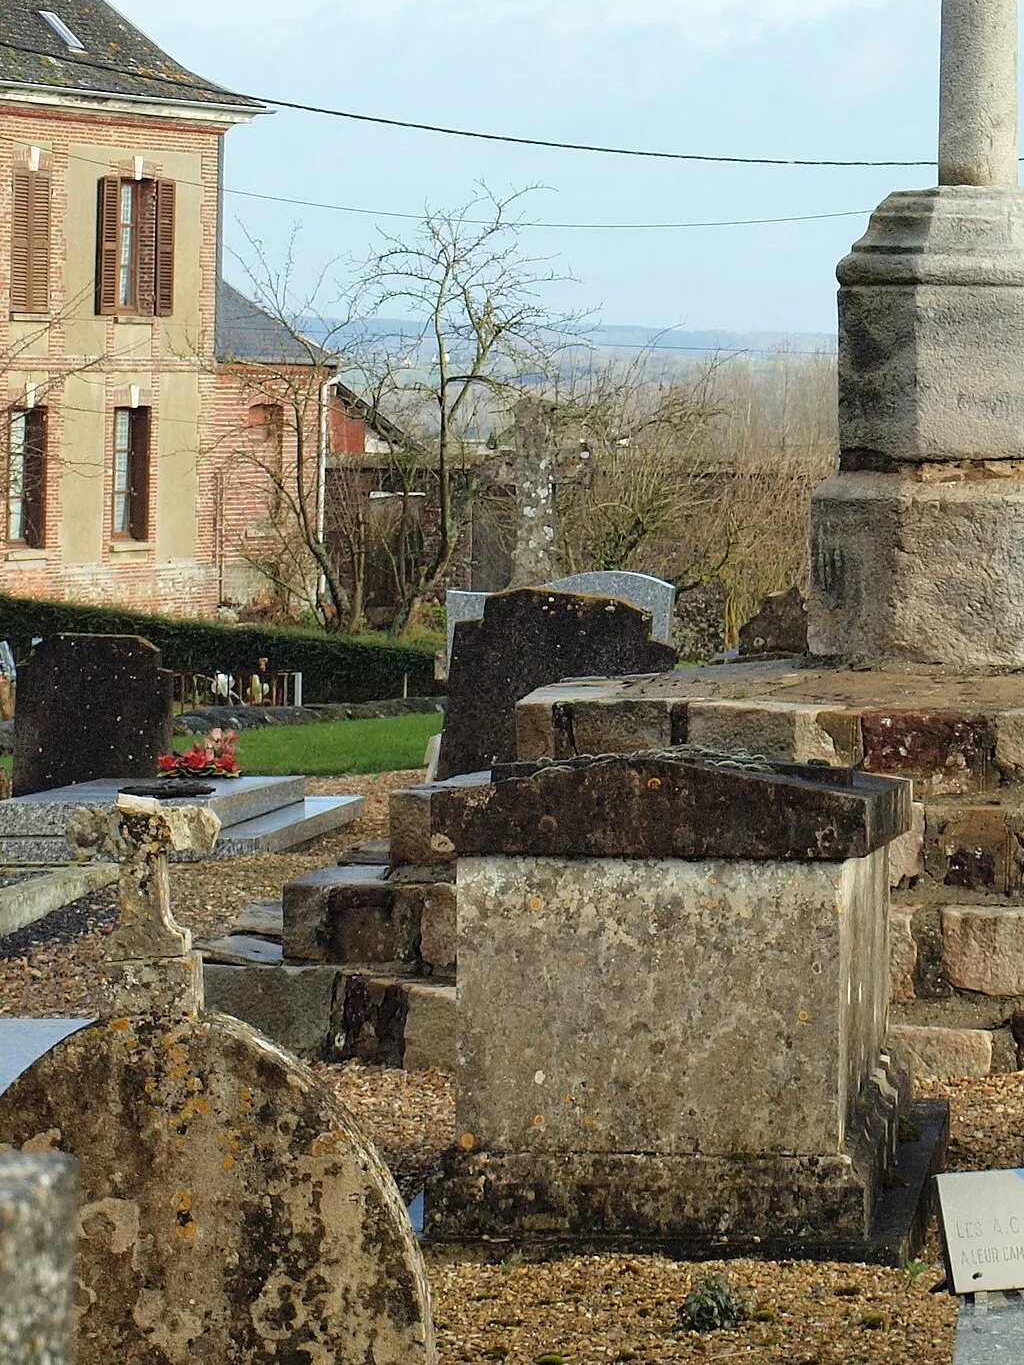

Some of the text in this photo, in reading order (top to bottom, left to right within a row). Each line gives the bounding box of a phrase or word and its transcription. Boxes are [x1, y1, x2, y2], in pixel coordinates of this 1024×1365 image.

[956, 1221, 983, 1238] LES
[961, 1250, 969, 1265] A
[971, 1248, 999, 1264] LEUR
